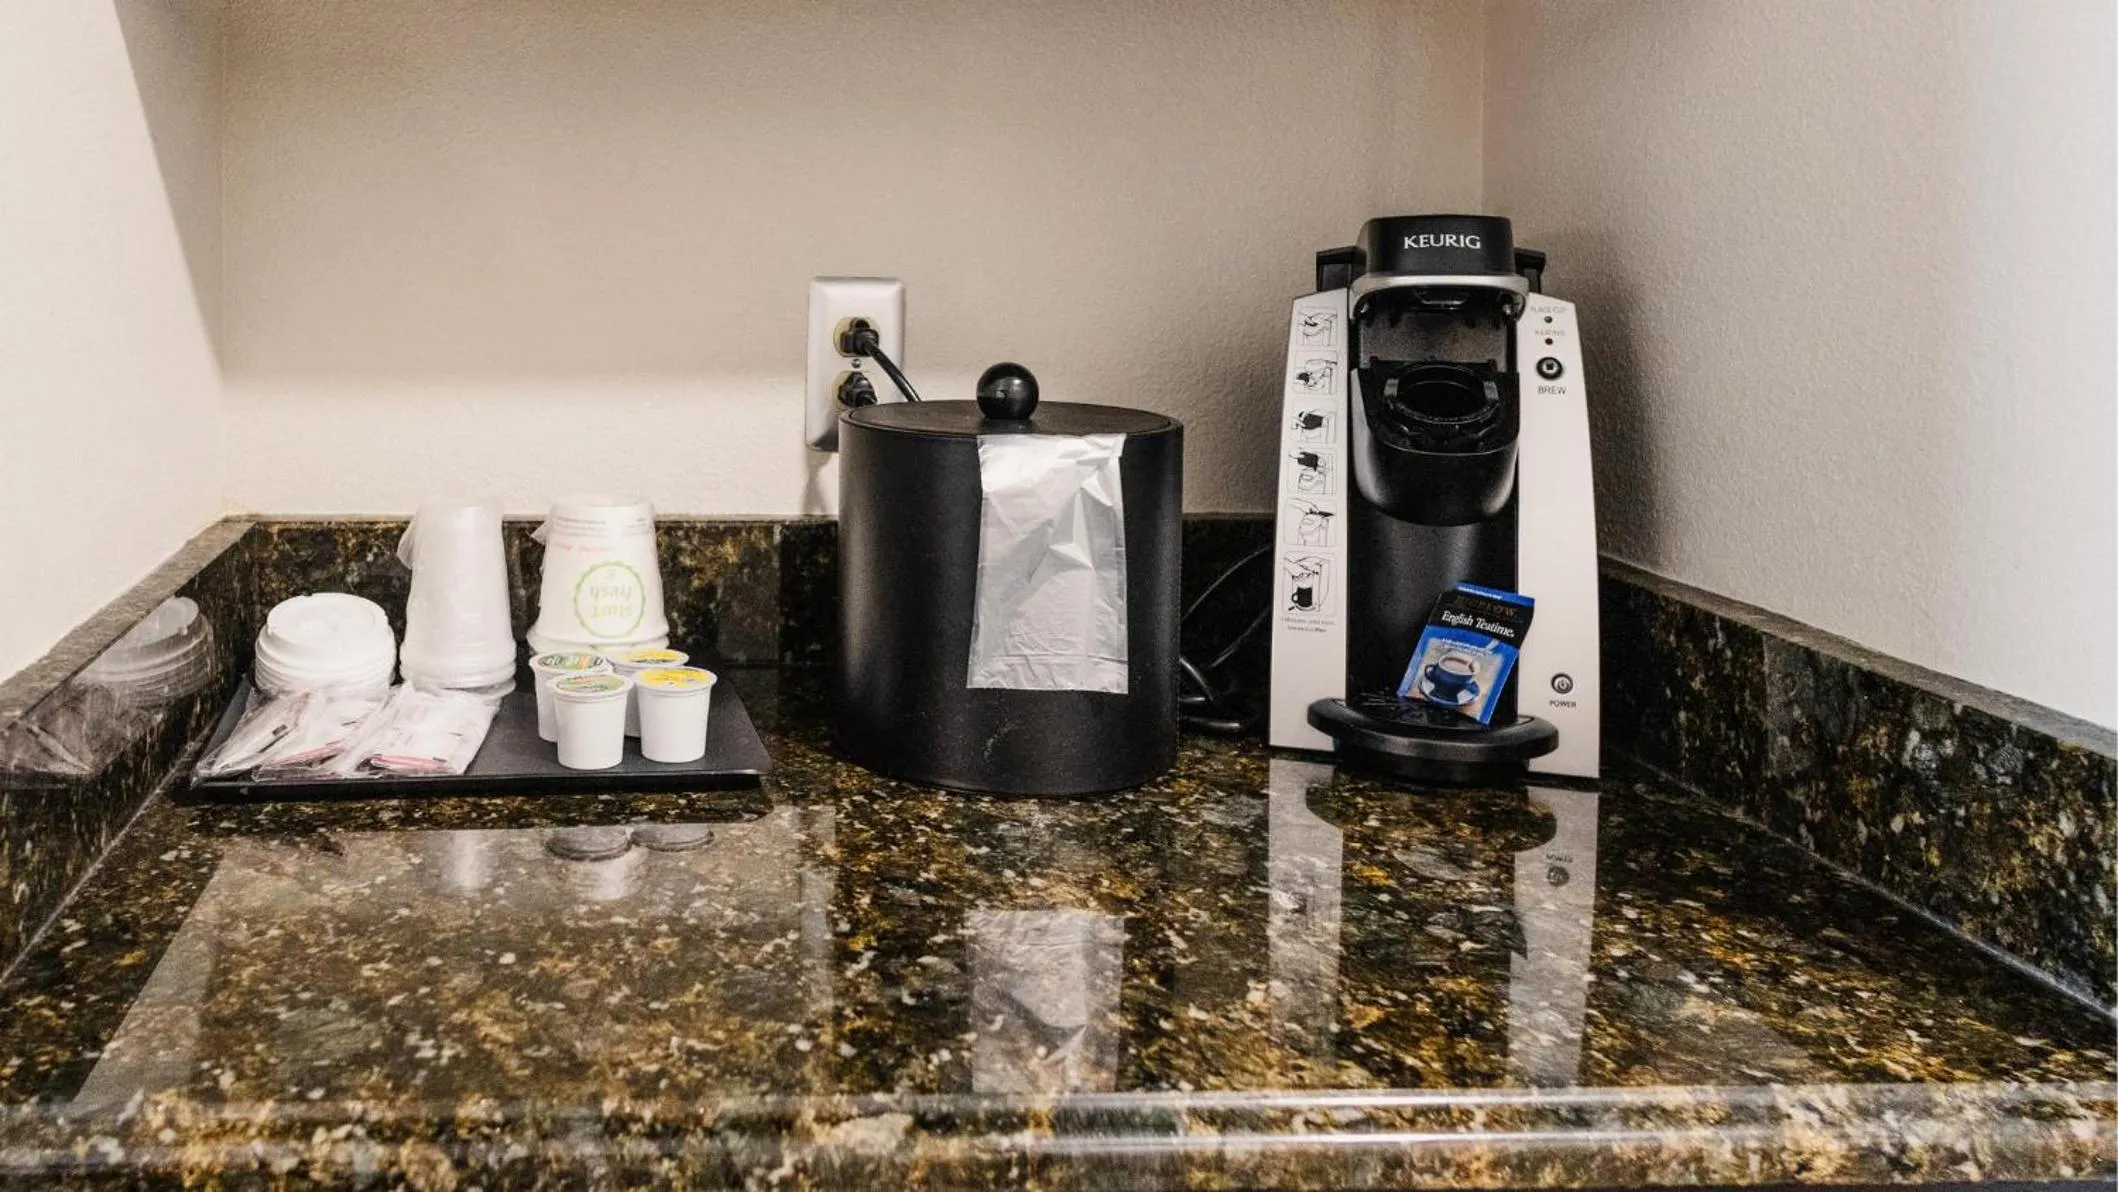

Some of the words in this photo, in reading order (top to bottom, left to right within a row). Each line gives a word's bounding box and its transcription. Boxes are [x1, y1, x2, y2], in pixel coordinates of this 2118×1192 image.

[1403, 233, 1481, 249] KEURIG
[1537, 385, 1567, 395] BREW
[589, 585, 633, 601] fresh
[1442, 610, 1474, 627] English
[1549, 700, 1577, 708] POWER
